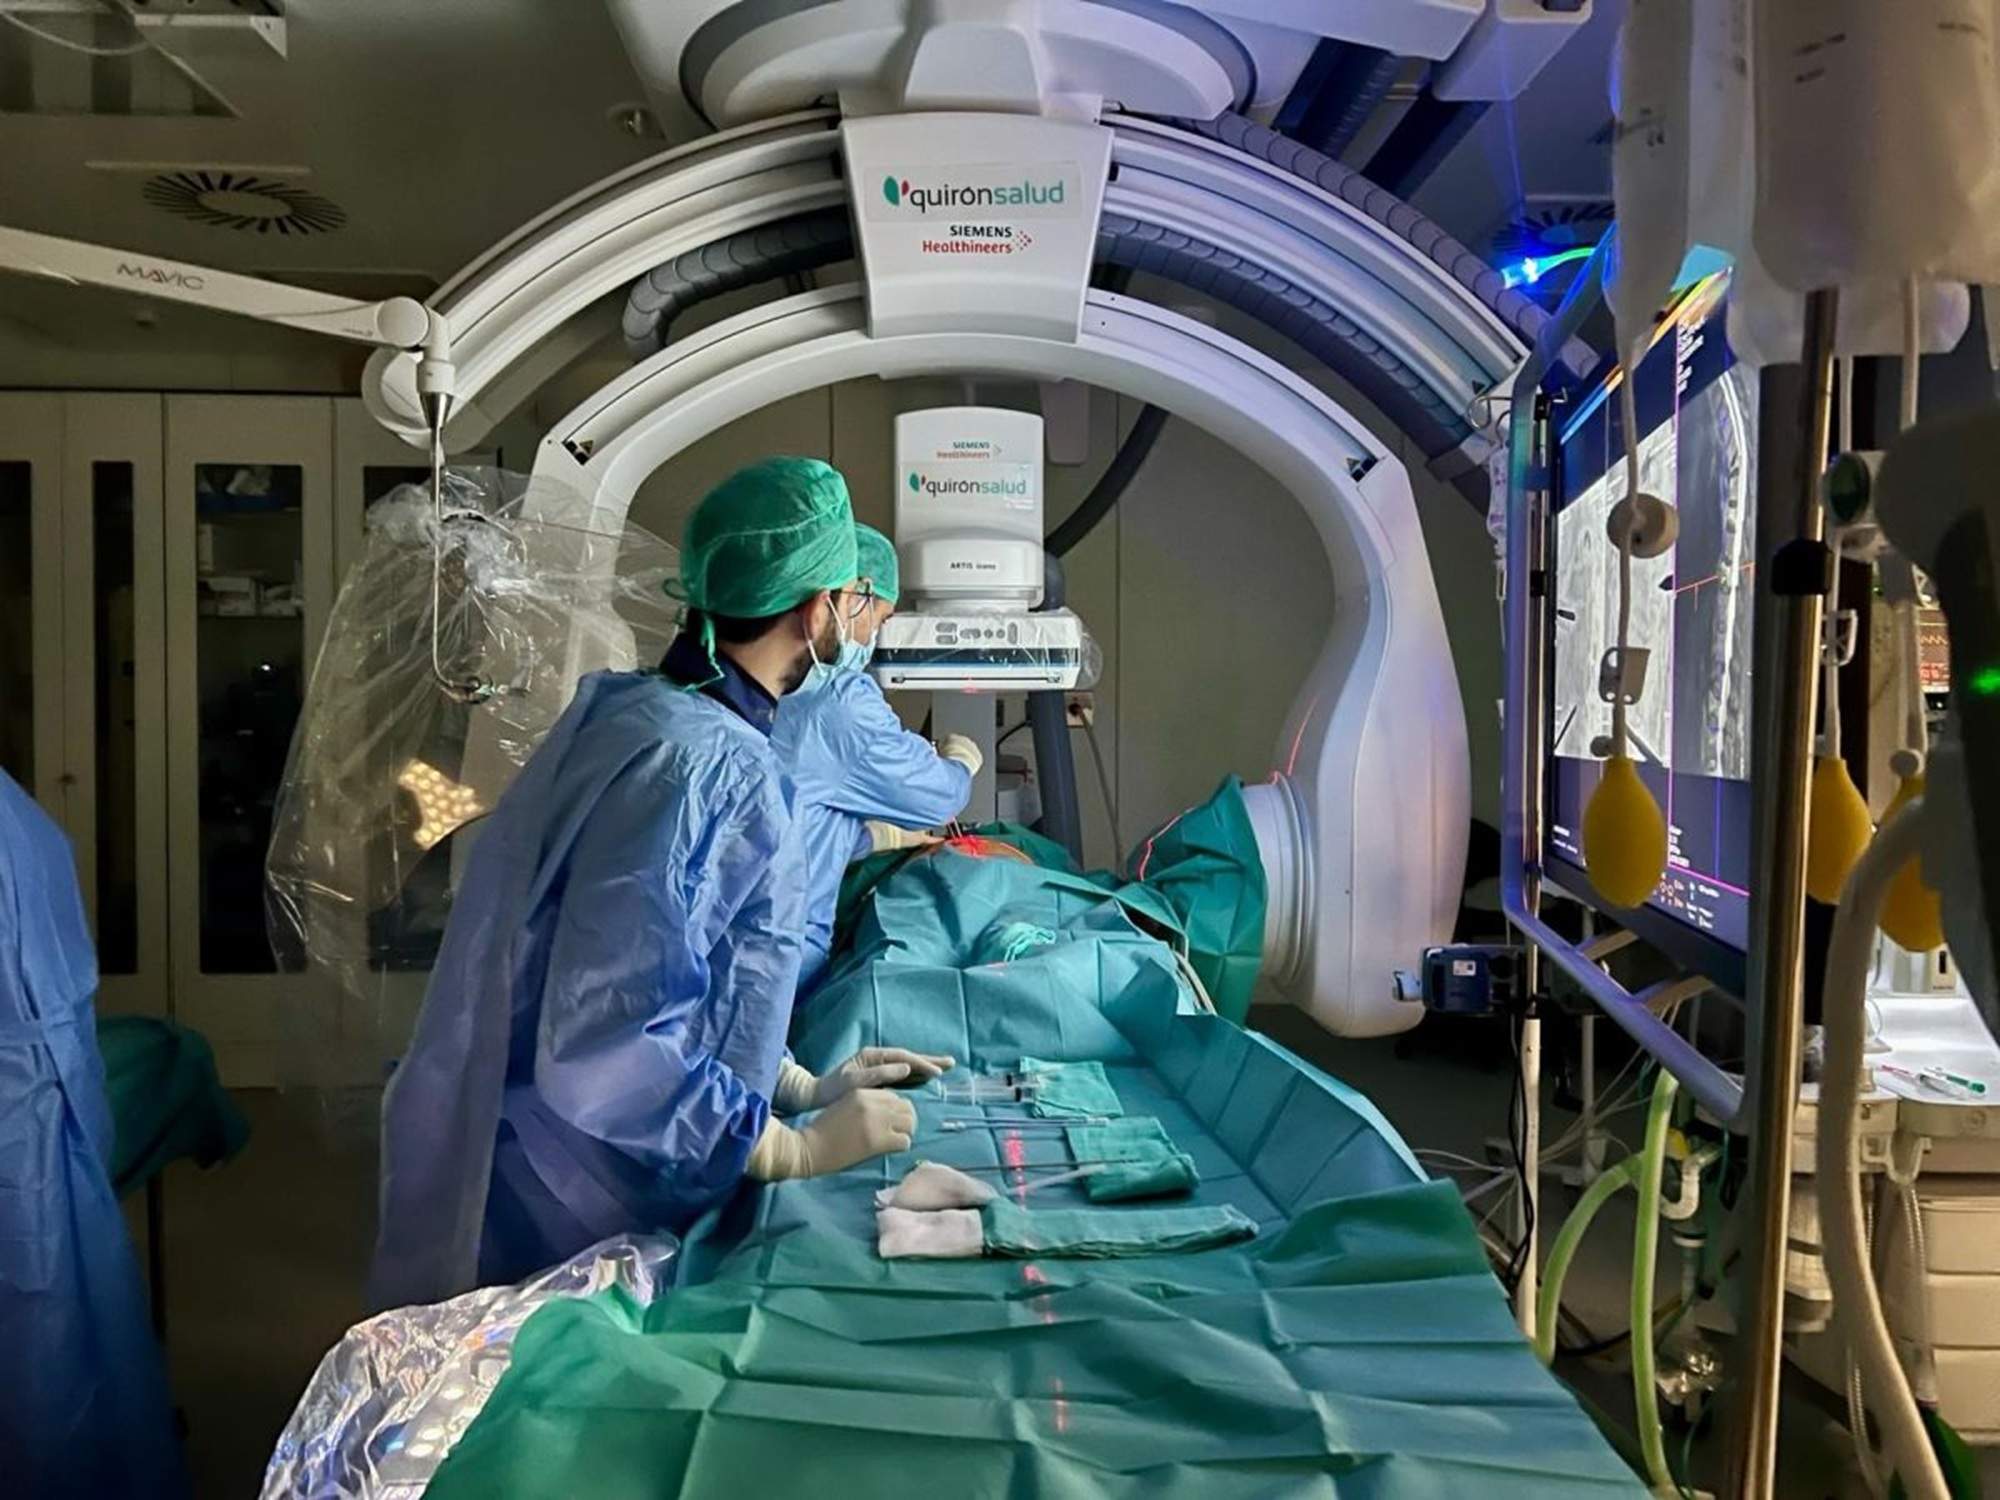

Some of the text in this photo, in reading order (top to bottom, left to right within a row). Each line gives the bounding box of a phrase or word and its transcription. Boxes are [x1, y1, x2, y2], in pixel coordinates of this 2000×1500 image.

[950, 225, 1012, 238] SIEMENS
[922, 240, 1012, 254] Healthineers
[117, 264, 204, 290] MAVIC
[953, 442, 990, 450] SIEMENS
[950, 562, 973, 570] ARTIS
